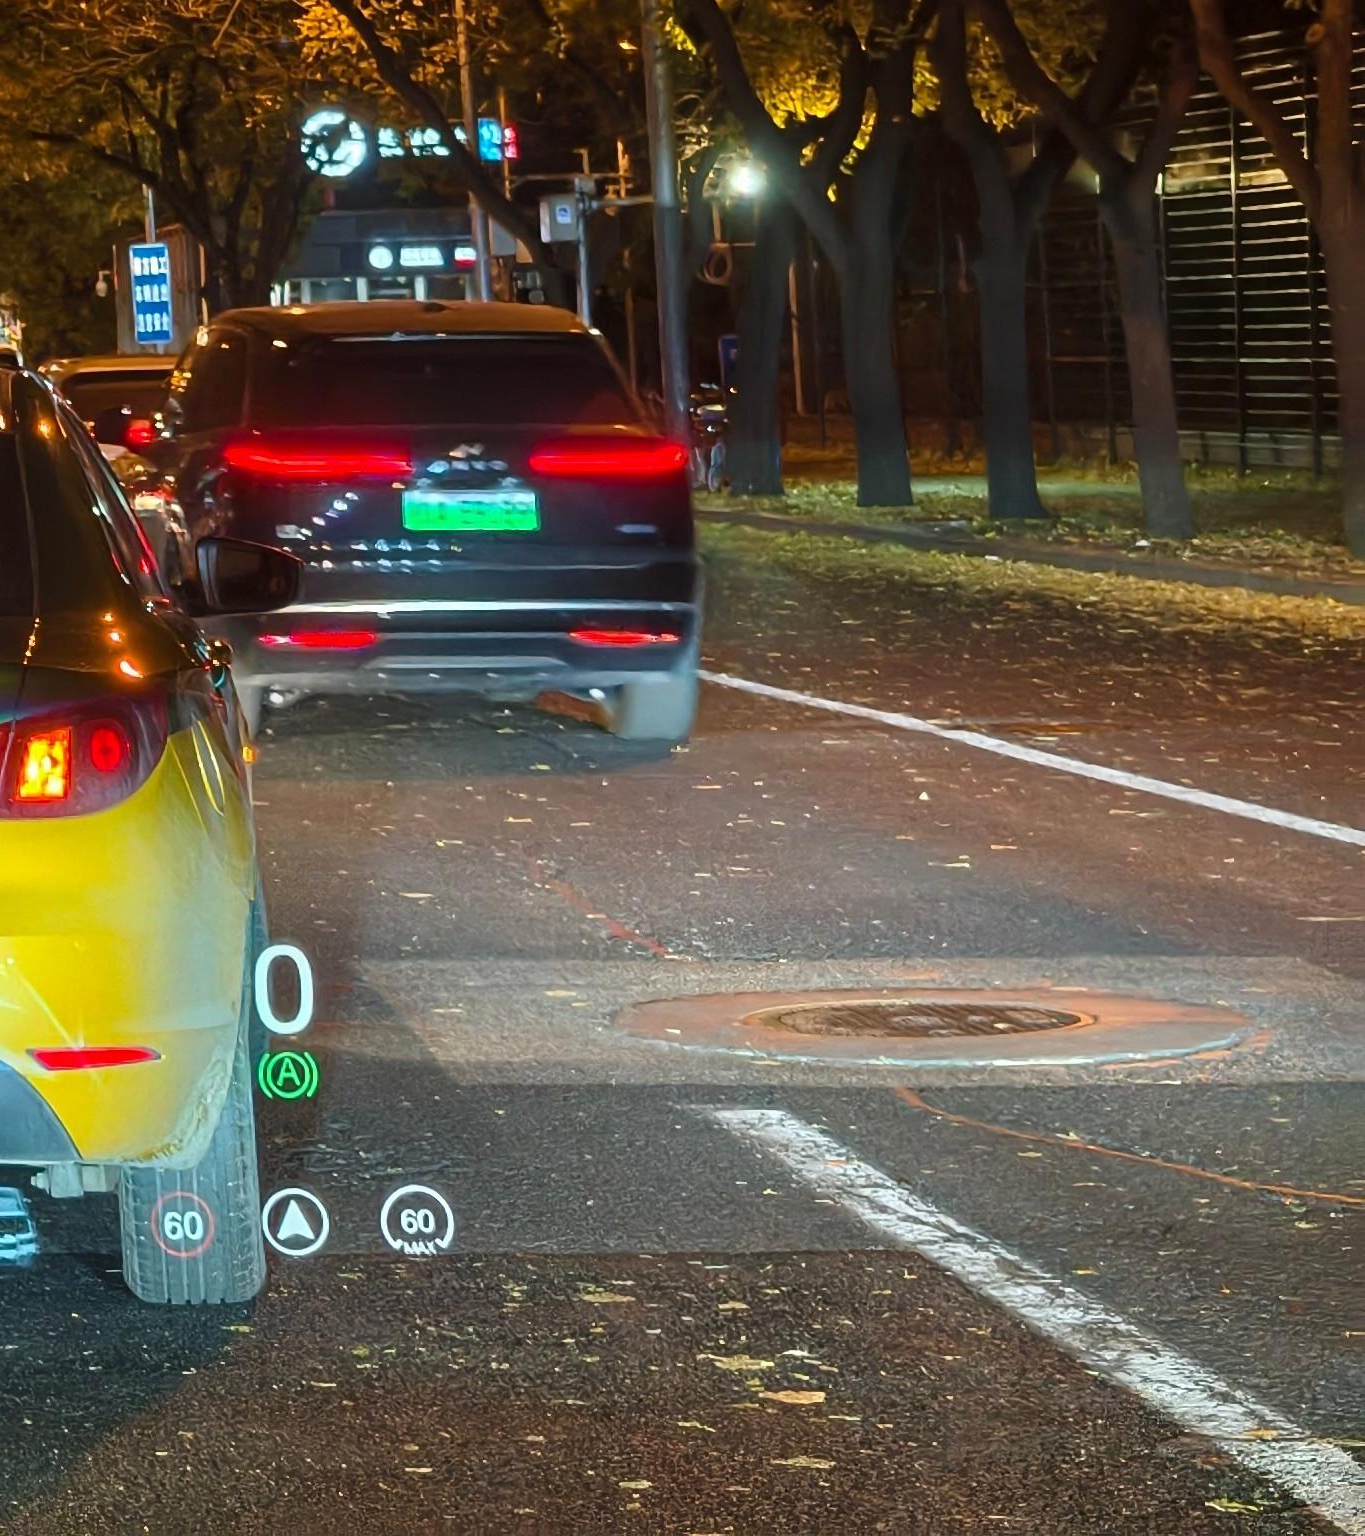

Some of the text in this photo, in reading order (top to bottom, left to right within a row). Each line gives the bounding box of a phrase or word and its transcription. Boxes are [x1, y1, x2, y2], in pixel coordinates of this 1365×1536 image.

[254, 944, 314, 1035] 0
[163, 1210, 204, 1240] 60
[400, 1208, 435, 1234] 60
